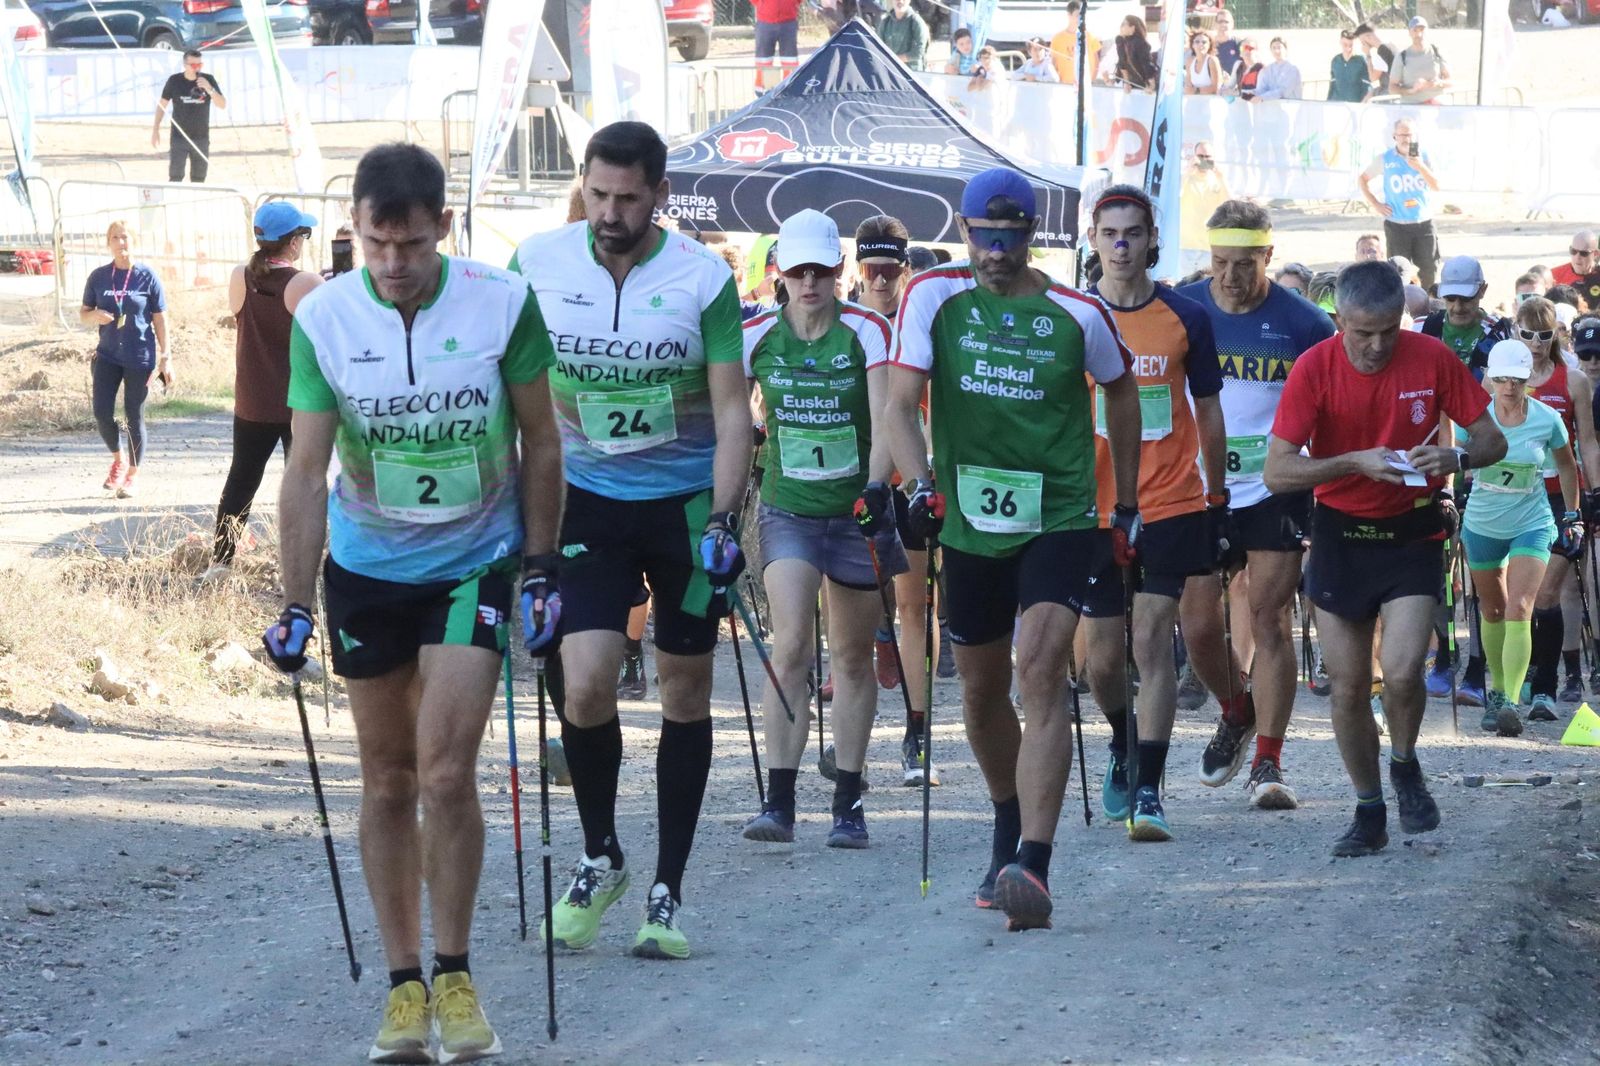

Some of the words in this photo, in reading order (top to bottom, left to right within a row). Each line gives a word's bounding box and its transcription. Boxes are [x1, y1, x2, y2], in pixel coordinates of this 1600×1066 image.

[781, 151, 961, 169] BULLONES
[868, 142, 961, 157] SIERRA
[667, 194, 717, 207] SIERRA
[974, 359, 1034, 383] Euskal
[960, 375, 1045, 400] Selekzioa
[783, 394, 839, 409] Euskal
[607, 409, 652, 438] 24
[775, 408, 852, 425] Selekzioa
[812, 446, 825, 468] 1
[1226, 450, 1242, 473] 8
[1501, 470, 1515, 487] 7
[416, 475, 440, 505] 2
[980, 487, 1018, 518] 36
